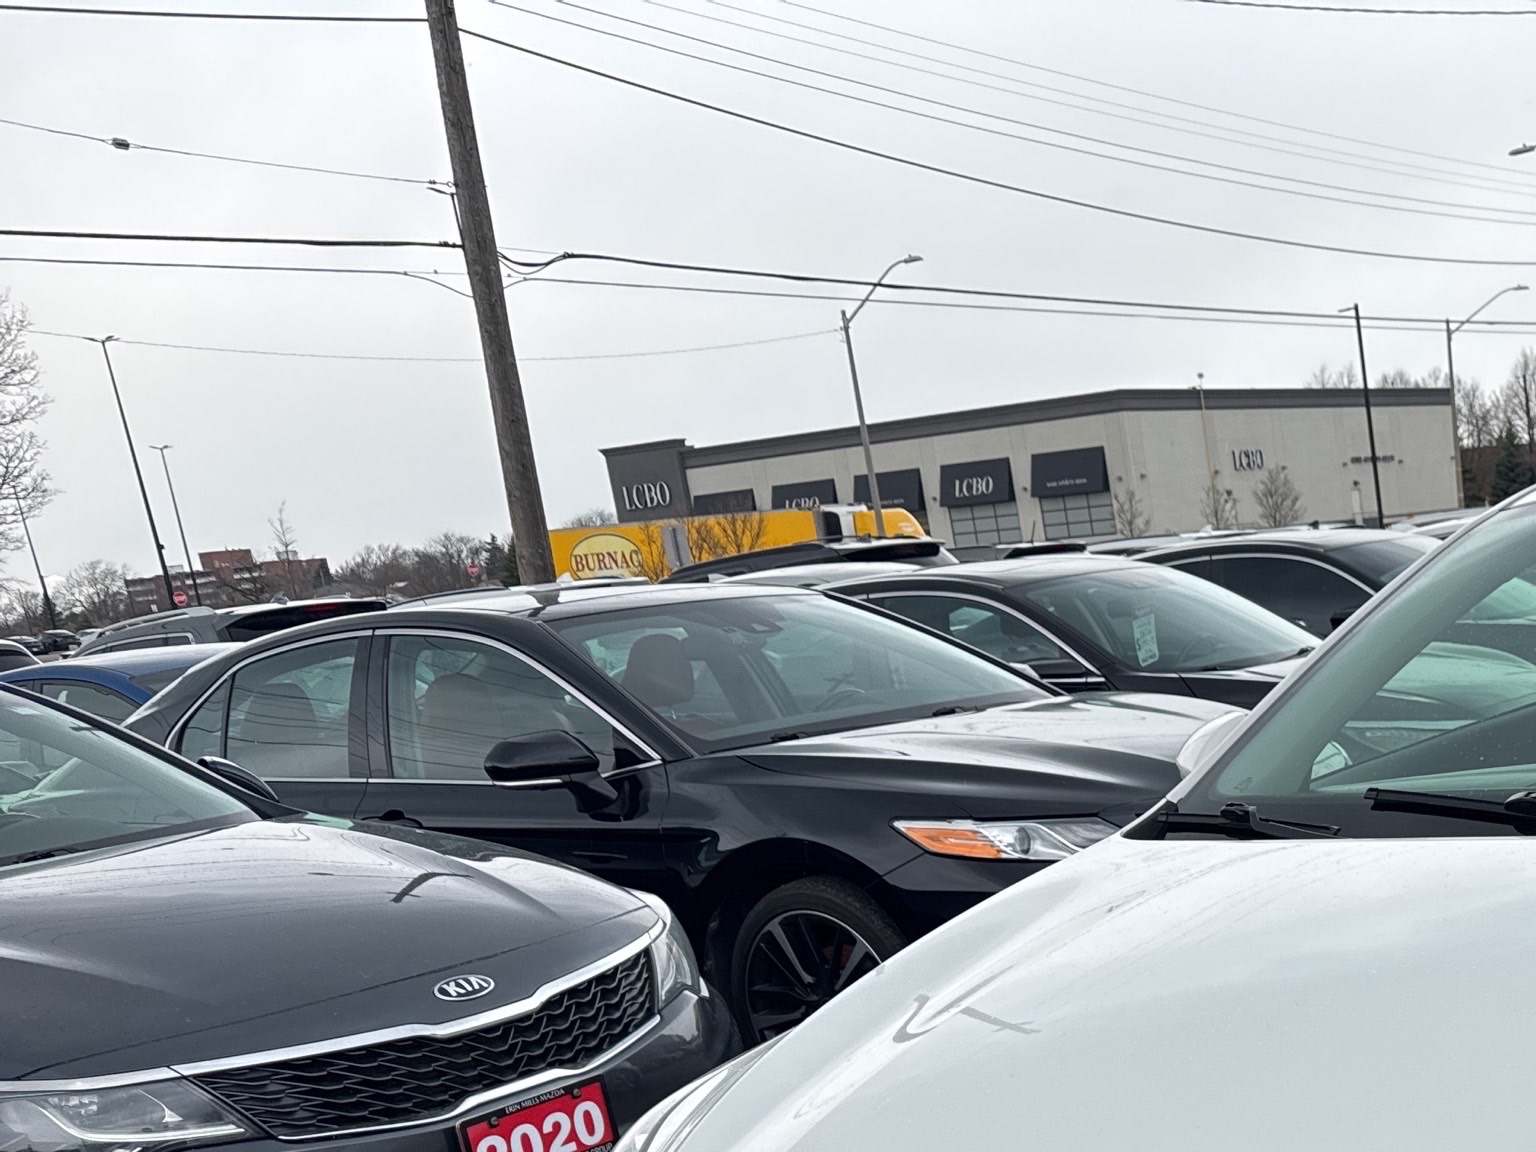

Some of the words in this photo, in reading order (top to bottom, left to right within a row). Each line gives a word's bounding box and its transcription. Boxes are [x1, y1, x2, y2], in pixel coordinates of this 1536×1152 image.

[1232, 449, 1264, 471] LCBO
[622, 481, 670, 510] LCBO
[955, 475, 994, 498] LCBO
[573, 549, 641, 572] BURNAC
[443, 976, 489, 997] KIA
[505, 1104, 521, 1114] ERIN
[521, 1096, 540, 1108] MILLS
[540, 1089, 565, 1101] MAZDA
